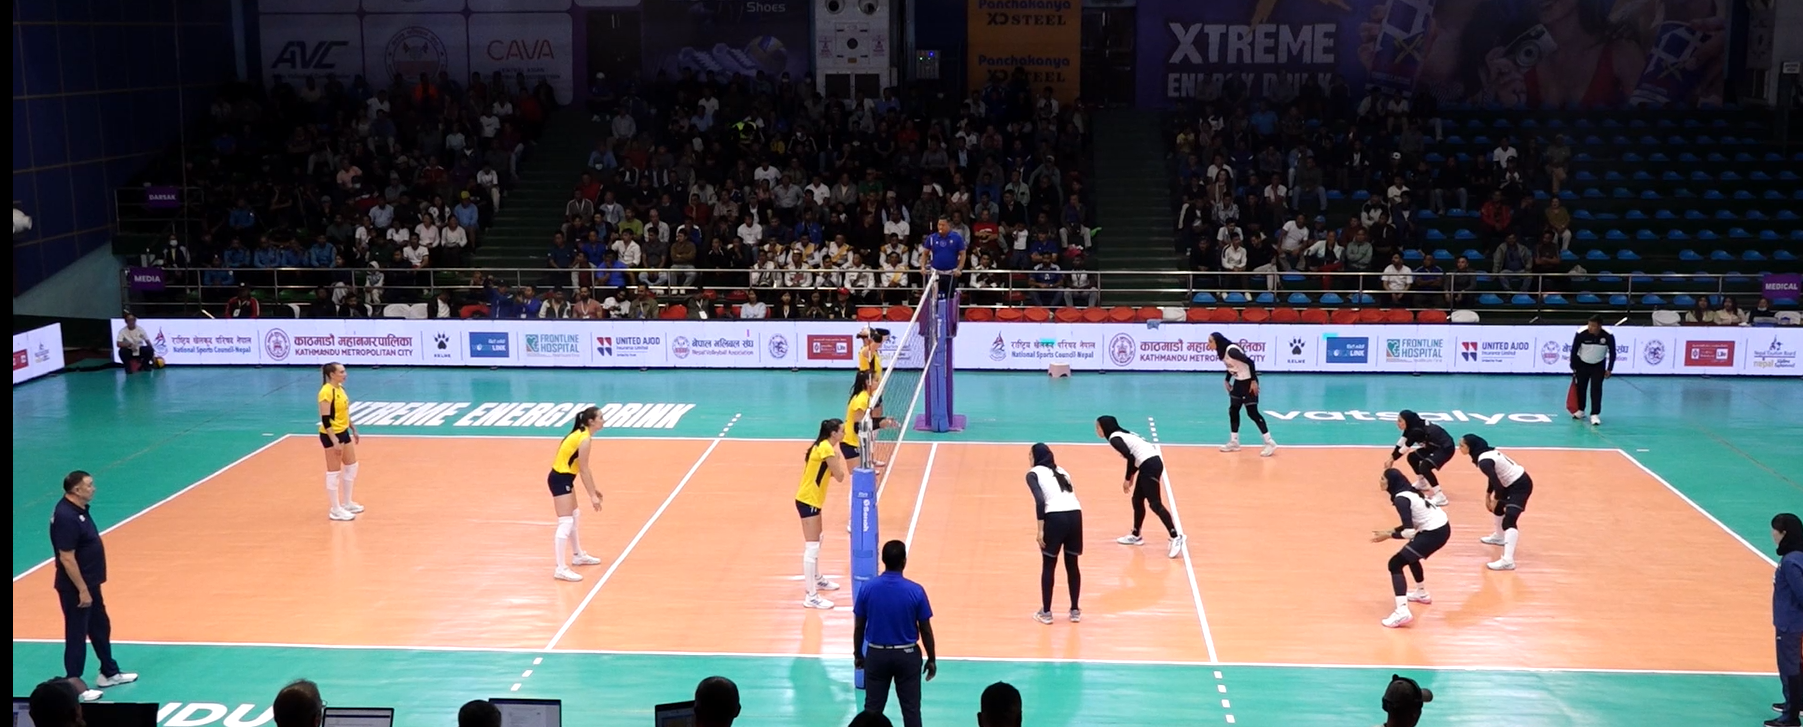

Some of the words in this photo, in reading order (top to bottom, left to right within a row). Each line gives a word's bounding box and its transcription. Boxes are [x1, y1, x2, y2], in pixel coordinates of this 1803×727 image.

[1012, 14, 1066, 25] STEEL
[1168, 22, 1337, 65] XTREME
[487, 40, 554, 60] CAVA
[271, 41, 349, 69] AVC
[979, 55, 1070, 68] Panchakanya
[1012, 71, 1065, 82] TEEL
[541, 334, 579, 342] FRONTLINE
[616, 337, 641, 345] UNITED
[541, 343, 579, 352] HOSPITAL
[692, 338, 711, 348] नेपाल
[1402, 339, 1443, 347] FRONTLINE
[1482, 342, 1509, 350] UNITED
[196, 346, 213, 355] Sports
[1036, 351, 1054, 359] Sports
[1402, 348, 1442, 357] HOSPITAL
[1140, 354, 1187, 362] KATHMANDU
[453, 402, 596, 427] ENERGY
[602, 402, 696, 429] DRINK
[1263, 410, 1553, 425] vatsalya
